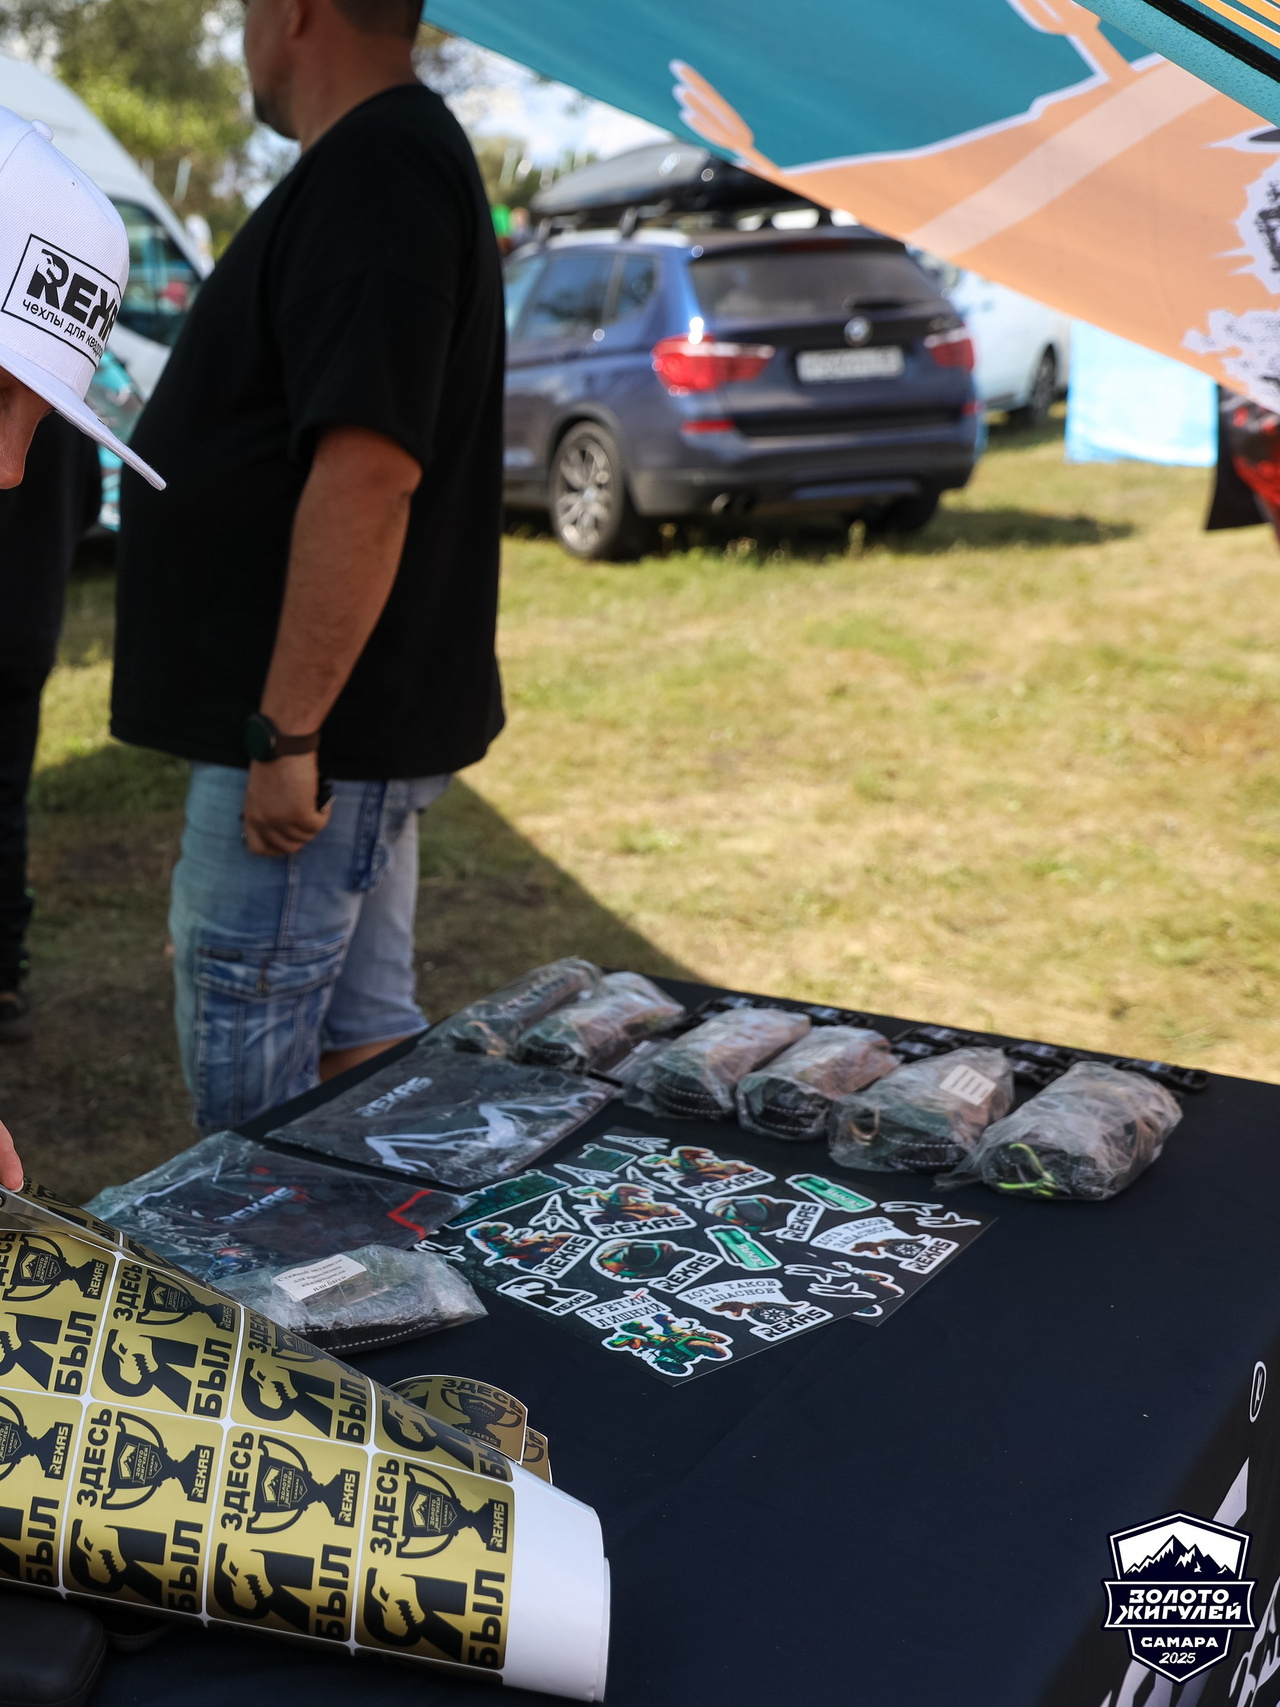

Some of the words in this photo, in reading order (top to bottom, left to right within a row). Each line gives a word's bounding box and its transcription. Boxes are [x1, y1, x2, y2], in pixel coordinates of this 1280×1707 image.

[26, 249, 118, 341] REXA
[22, 299, 65, 328] чехлы
[64, 322, 86, 339] для
[689, 1171, 770, 1197] REXAS
[598, 1216, 692, 1236] REXAS
[782, 1204, 819, 1239] REXAS
[535, 1235, 592, 1275] REXAS
[654, 1255, 718, 1291] REXAS
[905, 1241, 953, 1271] REXAS
[87, 1262, 105, 1296] REXAS
[113, 1264, 143, 1322] ЗДЕСЬ
[699, 1288, 776, 1305] ЗАПАСНОЕ
[724, 1281, 776, 1291] ТАКОЕ
[220, 1306, 233, 1330] REXAS
[553, 1293, 592, 1313] REXAS
[756, 1310, 826, 1338] REXAS
[54, 1311, 97, 1395] БЫЛ
[193, 1338, 232, 1418] БЫЛ
[442, 1379, 524, 1415] ЗДЕСЬ
[336, 1378, 367, 1444] БЫЛ
[49, 1426, 69, 1475] REXAS
[76, 1408, 113, 1508] ЗДЕСЬ
[191, 1449, 211, 1499] REXAS
[220, 1432, 255, 1531] ЗДЕСЬ
[338, 1473, 356, 1523] REXAS
[370, 1458, 400, 1556] ЗДЕСЬ
[490, 1502, 505, 1548] REXAS
[25, 1496, 60, 1587] БЫЛ
[167, 1519, 203, 1614] БЫЛ
[315, 1544, 352, 1640] БЫЛ
[468, 1569, 505, 1670] БЫЛ
